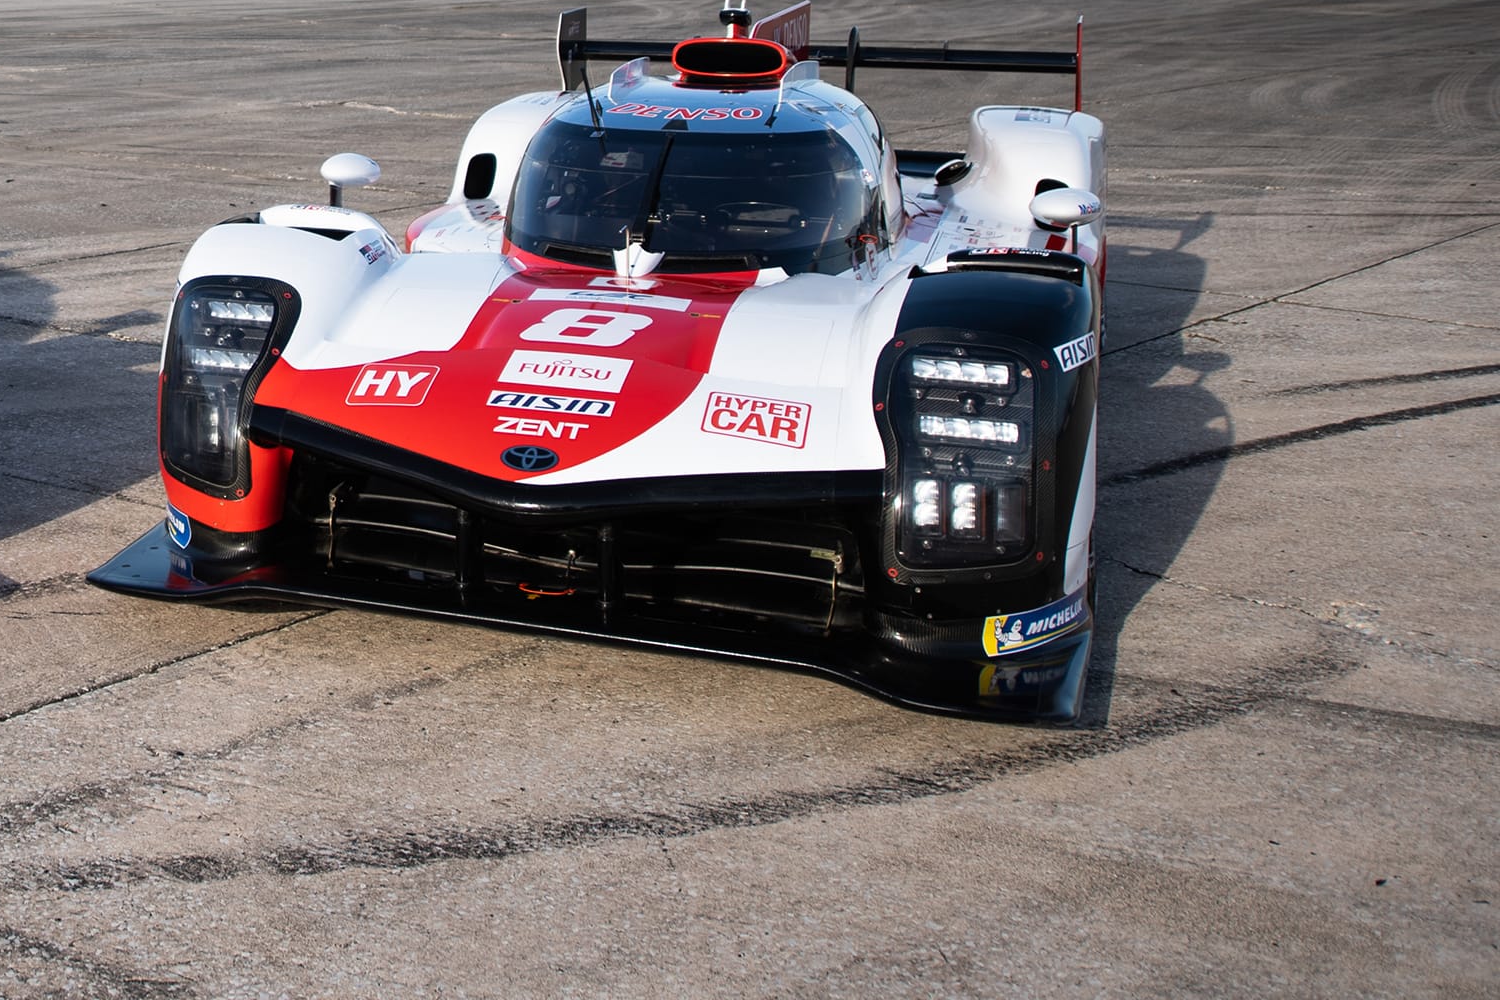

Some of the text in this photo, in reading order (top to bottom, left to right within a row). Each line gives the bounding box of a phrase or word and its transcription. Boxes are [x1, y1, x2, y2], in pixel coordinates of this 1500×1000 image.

[606, 102, 763, 121] DENSO
[519, 308, 654, 348] 8
[518, 360, 613, 381] FUJITSU
[354, 369, 431, 397] HY
[490, 393, 611, 415] AISIN
[714, 395, 802, 419] HYPER
[493, 416, 590, 440] ZENT
[710, 408, 799, 442] CAR
[1025, 597, 1083, 636] MICHELIN
